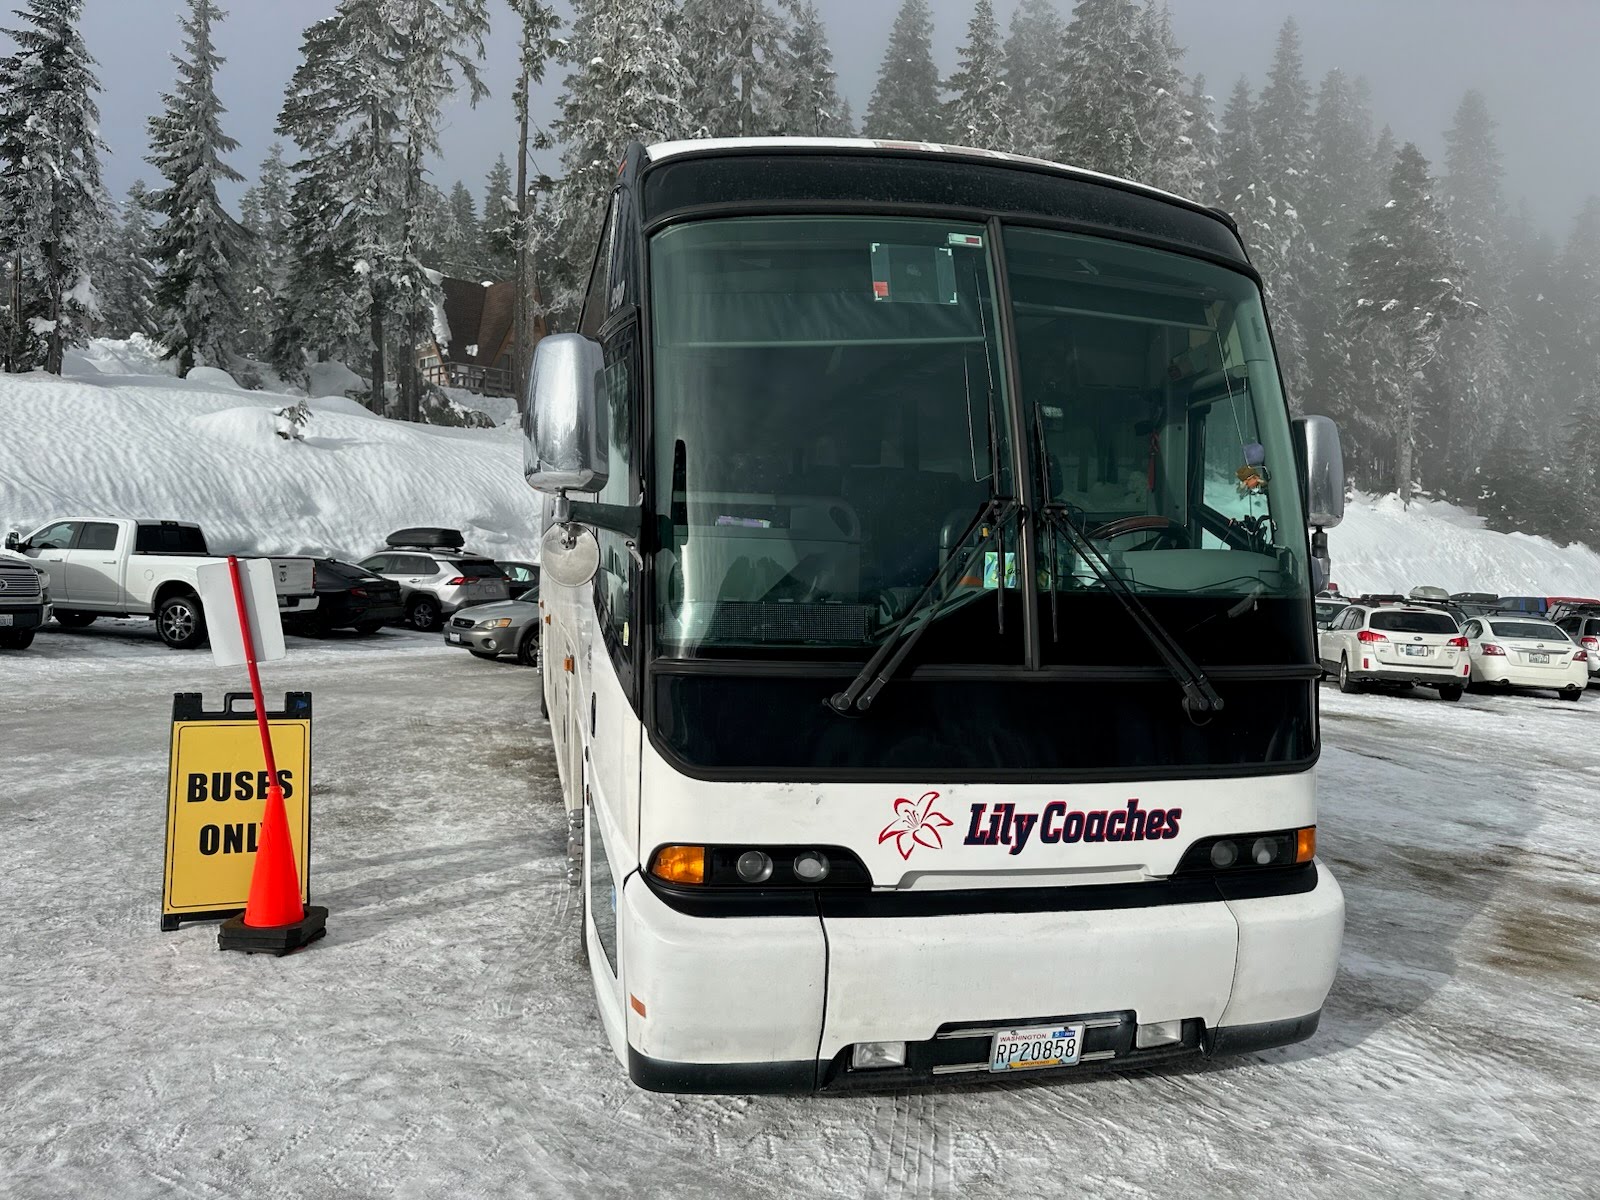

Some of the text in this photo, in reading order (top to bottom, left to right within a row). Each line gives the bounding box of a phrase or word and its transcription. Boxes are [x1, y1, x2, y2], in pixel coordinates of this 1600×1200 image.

[187, 770, 293, 802] BUSES
[199, 822, 263, 856] ONL
[963, 798, 1182, 856] Lily Coaches
[996, 1038, 1076, 1063] RP20858
[1000, 1034, 1047, 1042] WASHINGTON
